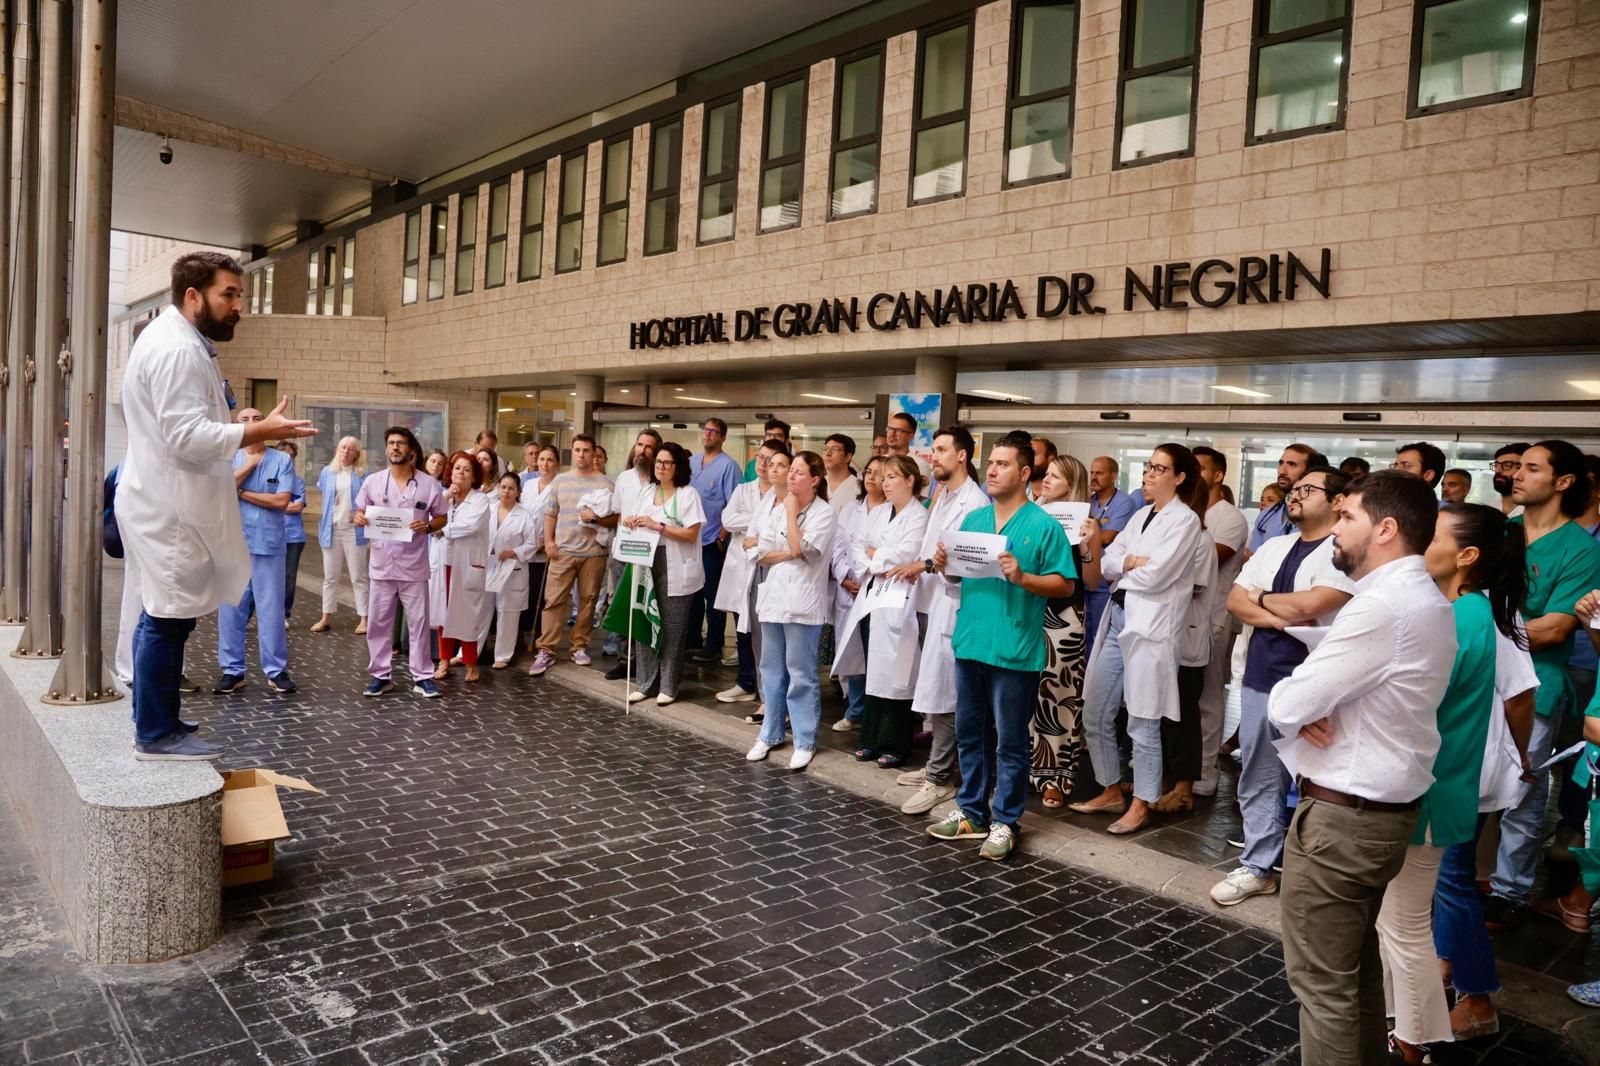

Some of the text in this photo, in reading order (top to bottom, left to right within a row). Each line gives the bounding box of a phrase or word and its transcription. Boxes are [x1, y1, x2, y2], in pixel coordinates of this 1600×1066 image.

[630, 248, 1331, 350] HOSPITAL DE GRAN CANARIA DR. NEGRIN
